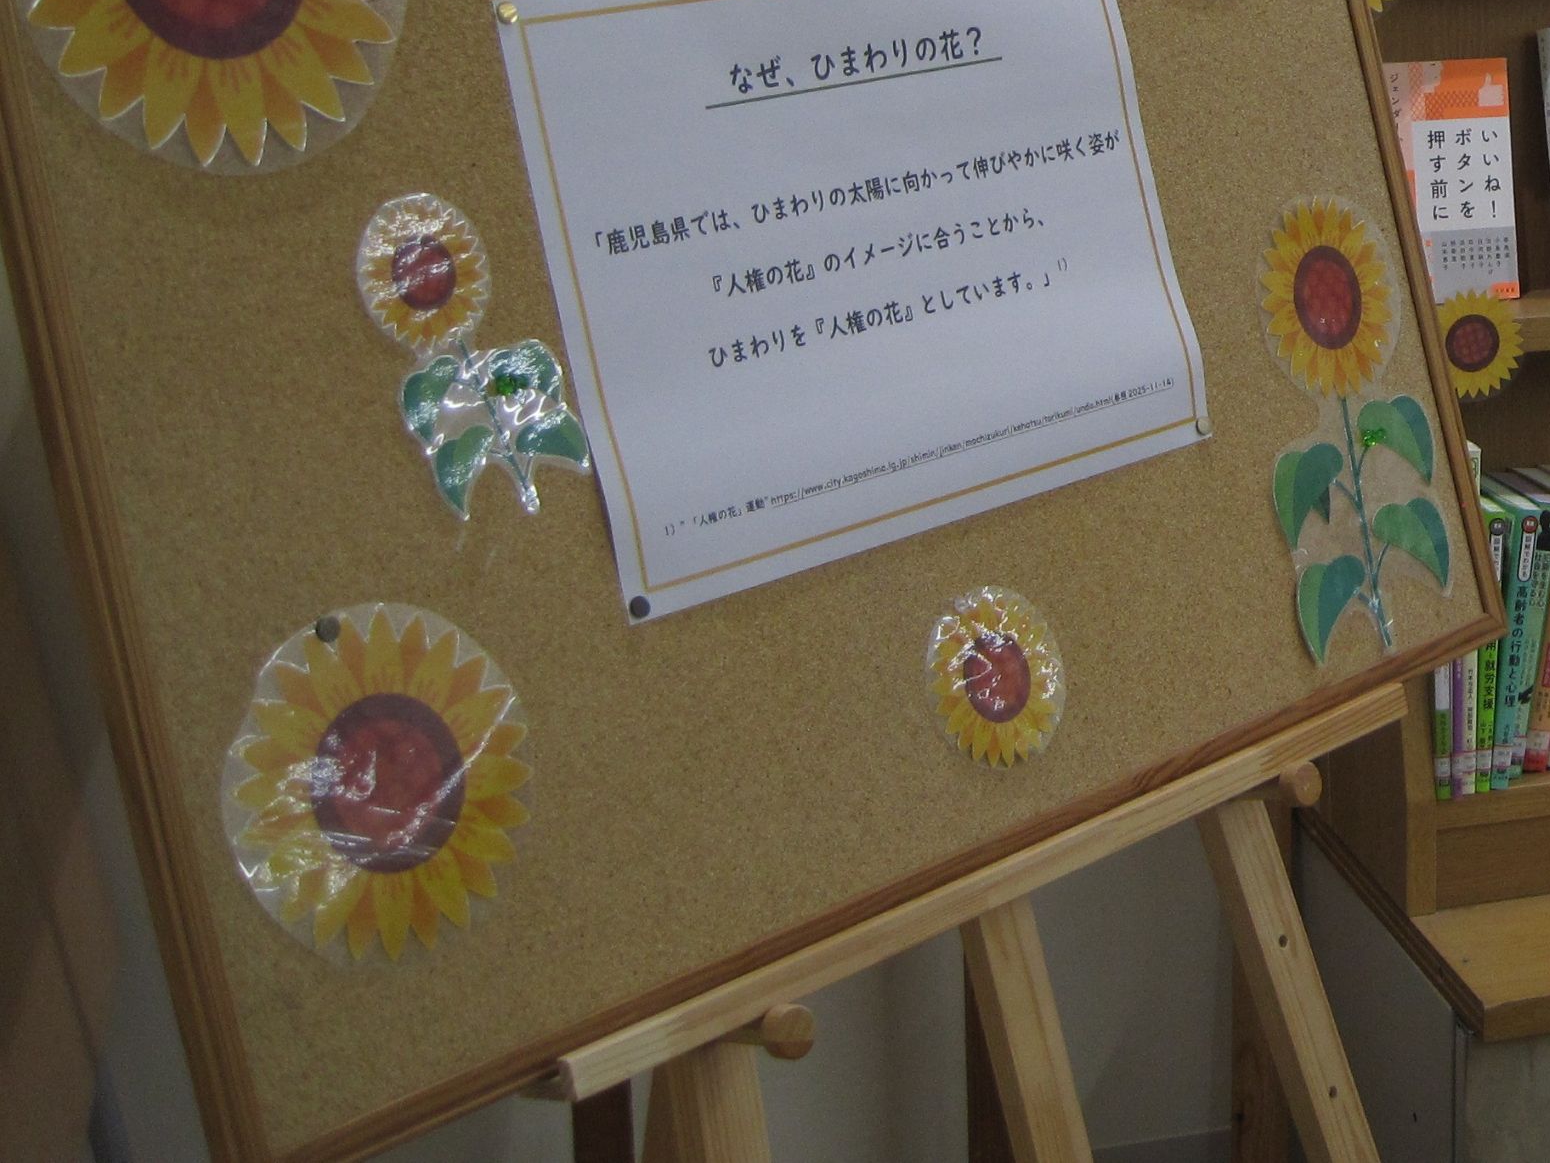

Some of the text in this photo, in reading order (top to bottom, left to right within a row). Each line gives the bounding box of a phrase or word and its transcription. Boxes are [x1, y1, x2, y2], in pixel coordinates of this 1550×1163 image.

[729, 26, 983, 95] なぜ、ひまわりの花?
[592, 129, 1120, 257] 「鹿児島県では、ひまわりの太陽に向かって伸びやかに咲く姿が
[1427, 129, 1449, 221] 押す前に
[1455, 128, 1475, 218] ボタンを
[1481, 128, 1501, 219] いいね!
[711, 217, 1046, 297] 『人権の花』のイメージに合うことから、
[707, 271, 1053, 369] ひまわりを『人権の花』としています。」
[1502, 584, 1530, 710] 高齢者の行動と心理
